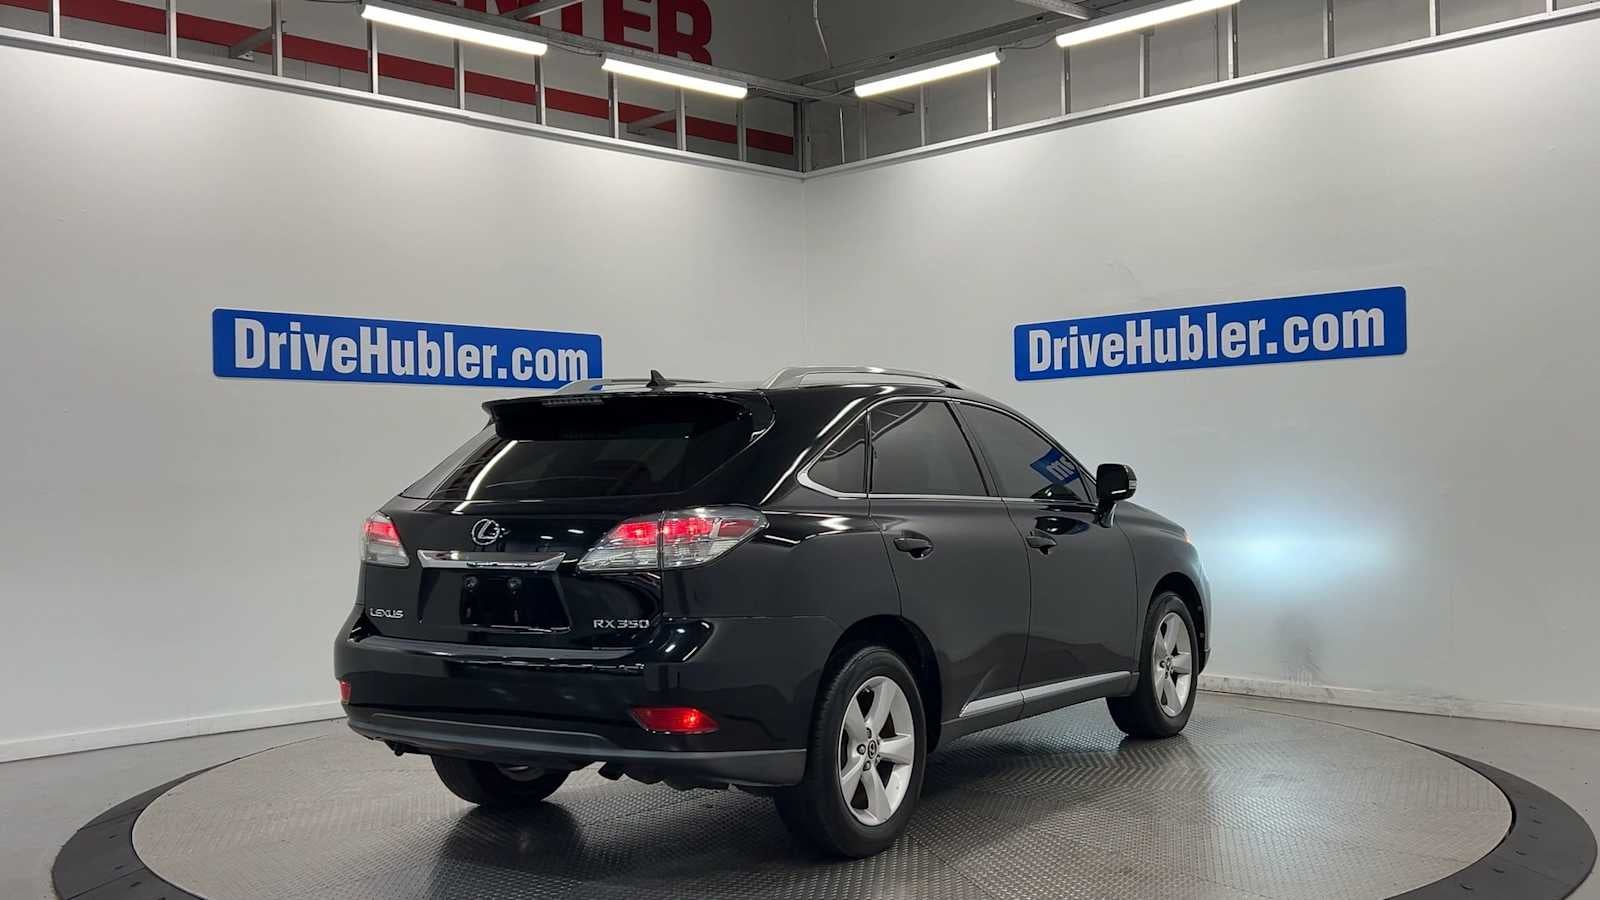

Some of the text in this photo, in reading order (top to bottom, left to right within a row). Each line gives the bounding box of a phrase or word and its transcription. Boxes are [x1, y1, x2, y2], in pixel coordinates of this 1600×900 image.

[234, 317, 588, 382] DriveHubler.com
[1028, 306, 1385, 373] DriveHubler.com
[369, 607, 404, 619] LEXUS
